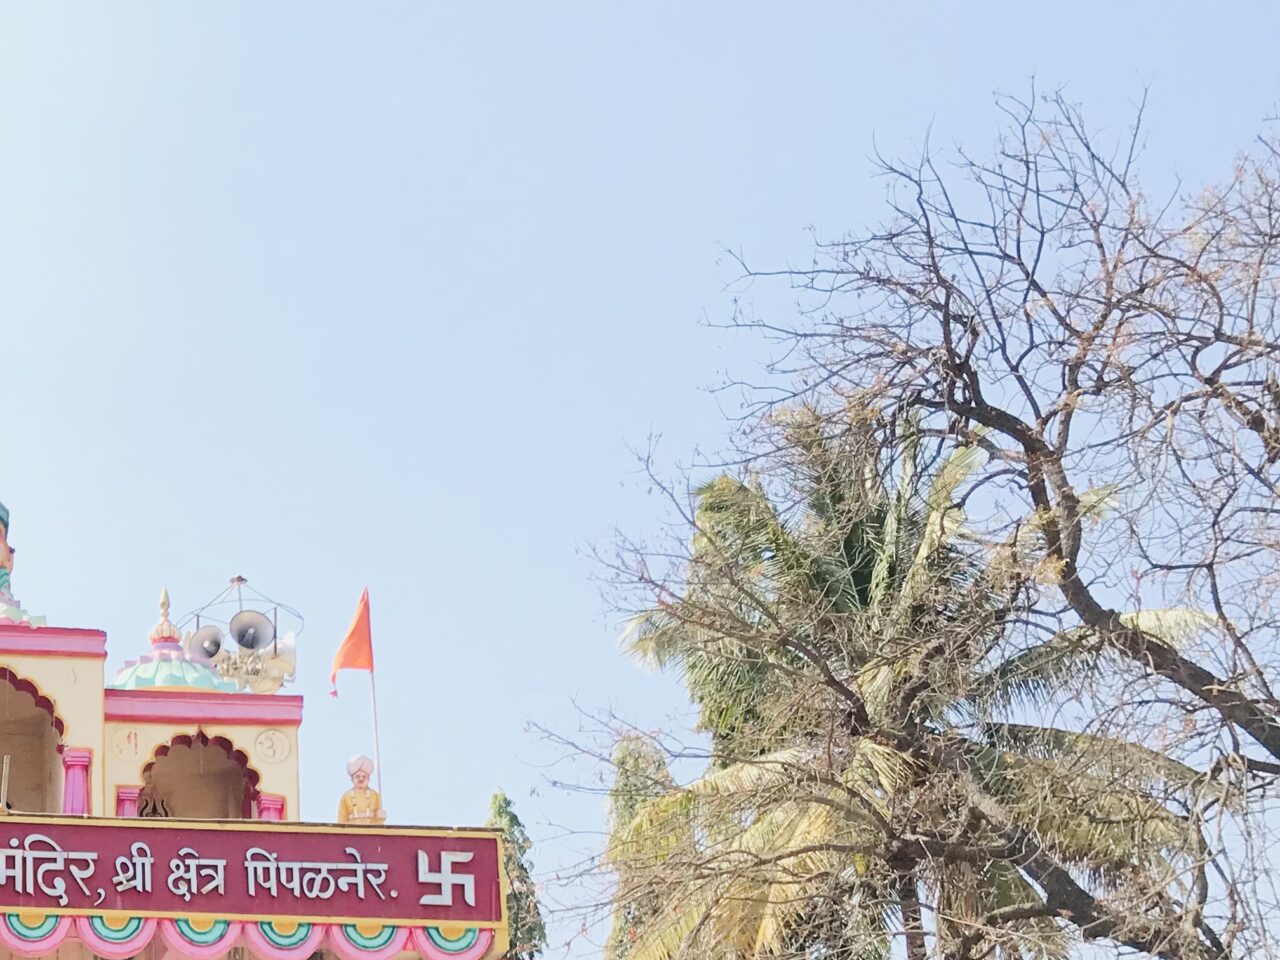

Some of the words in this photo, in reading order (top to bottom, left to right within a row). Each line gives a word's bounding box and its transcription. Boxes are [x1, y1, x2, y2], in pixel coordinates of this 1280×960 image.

[111, 841, 154, 894] श्री
[166, 847, 227, 902] क्षेत्र
[244, 847, 400, 901] पिंपळनेर.
